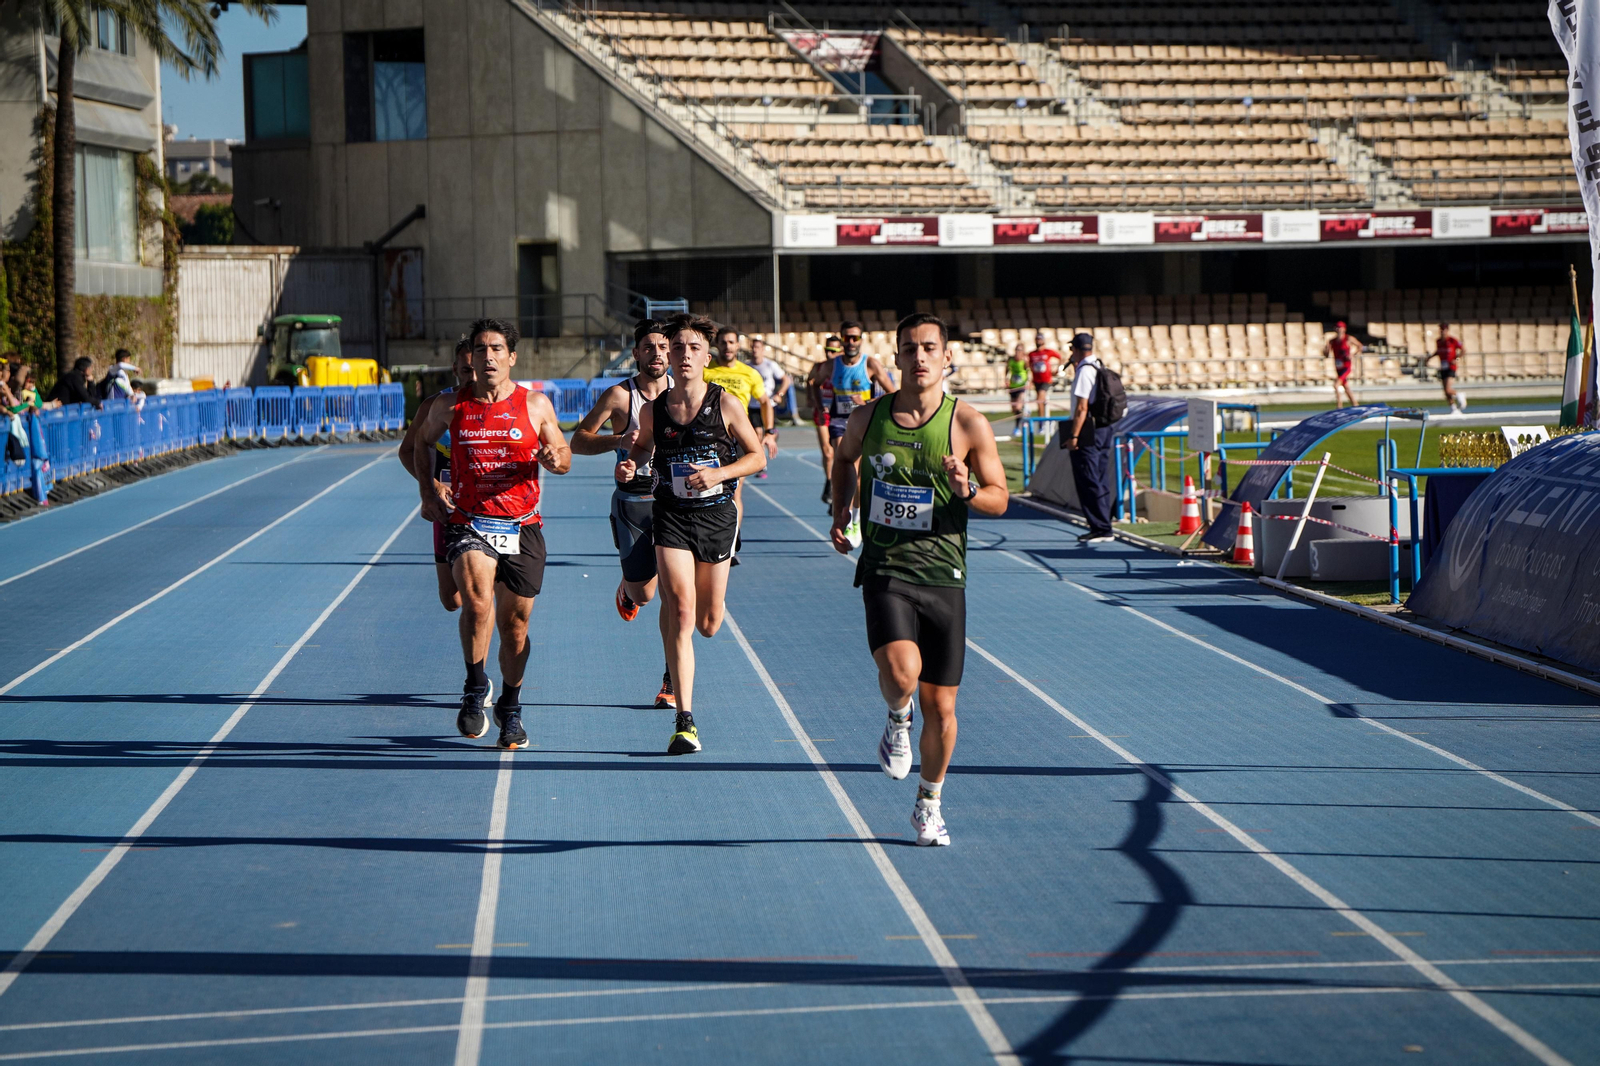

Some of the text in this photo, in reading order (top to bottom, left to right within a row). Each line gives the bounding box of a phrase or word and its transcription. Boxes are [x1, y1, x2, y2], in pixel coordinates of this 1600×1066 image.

[997, 222, 1038, 236] PLAY
[1158, 220, 1201, 235] PLAY
[1191, 218, 1247, 241] JEREZ
[1324, 218, 1368, 231] PLAY
[1357, 215, 1416, 238] JEREZ
[1495, 214, 1540, 228] PLAY
[1530, 211, 1589, 233] JEREZ
[458, 428, 509, 439] Movijerez
[482, 461, 518, 470] FITNESS
[883, 501, 917, 520] 898
